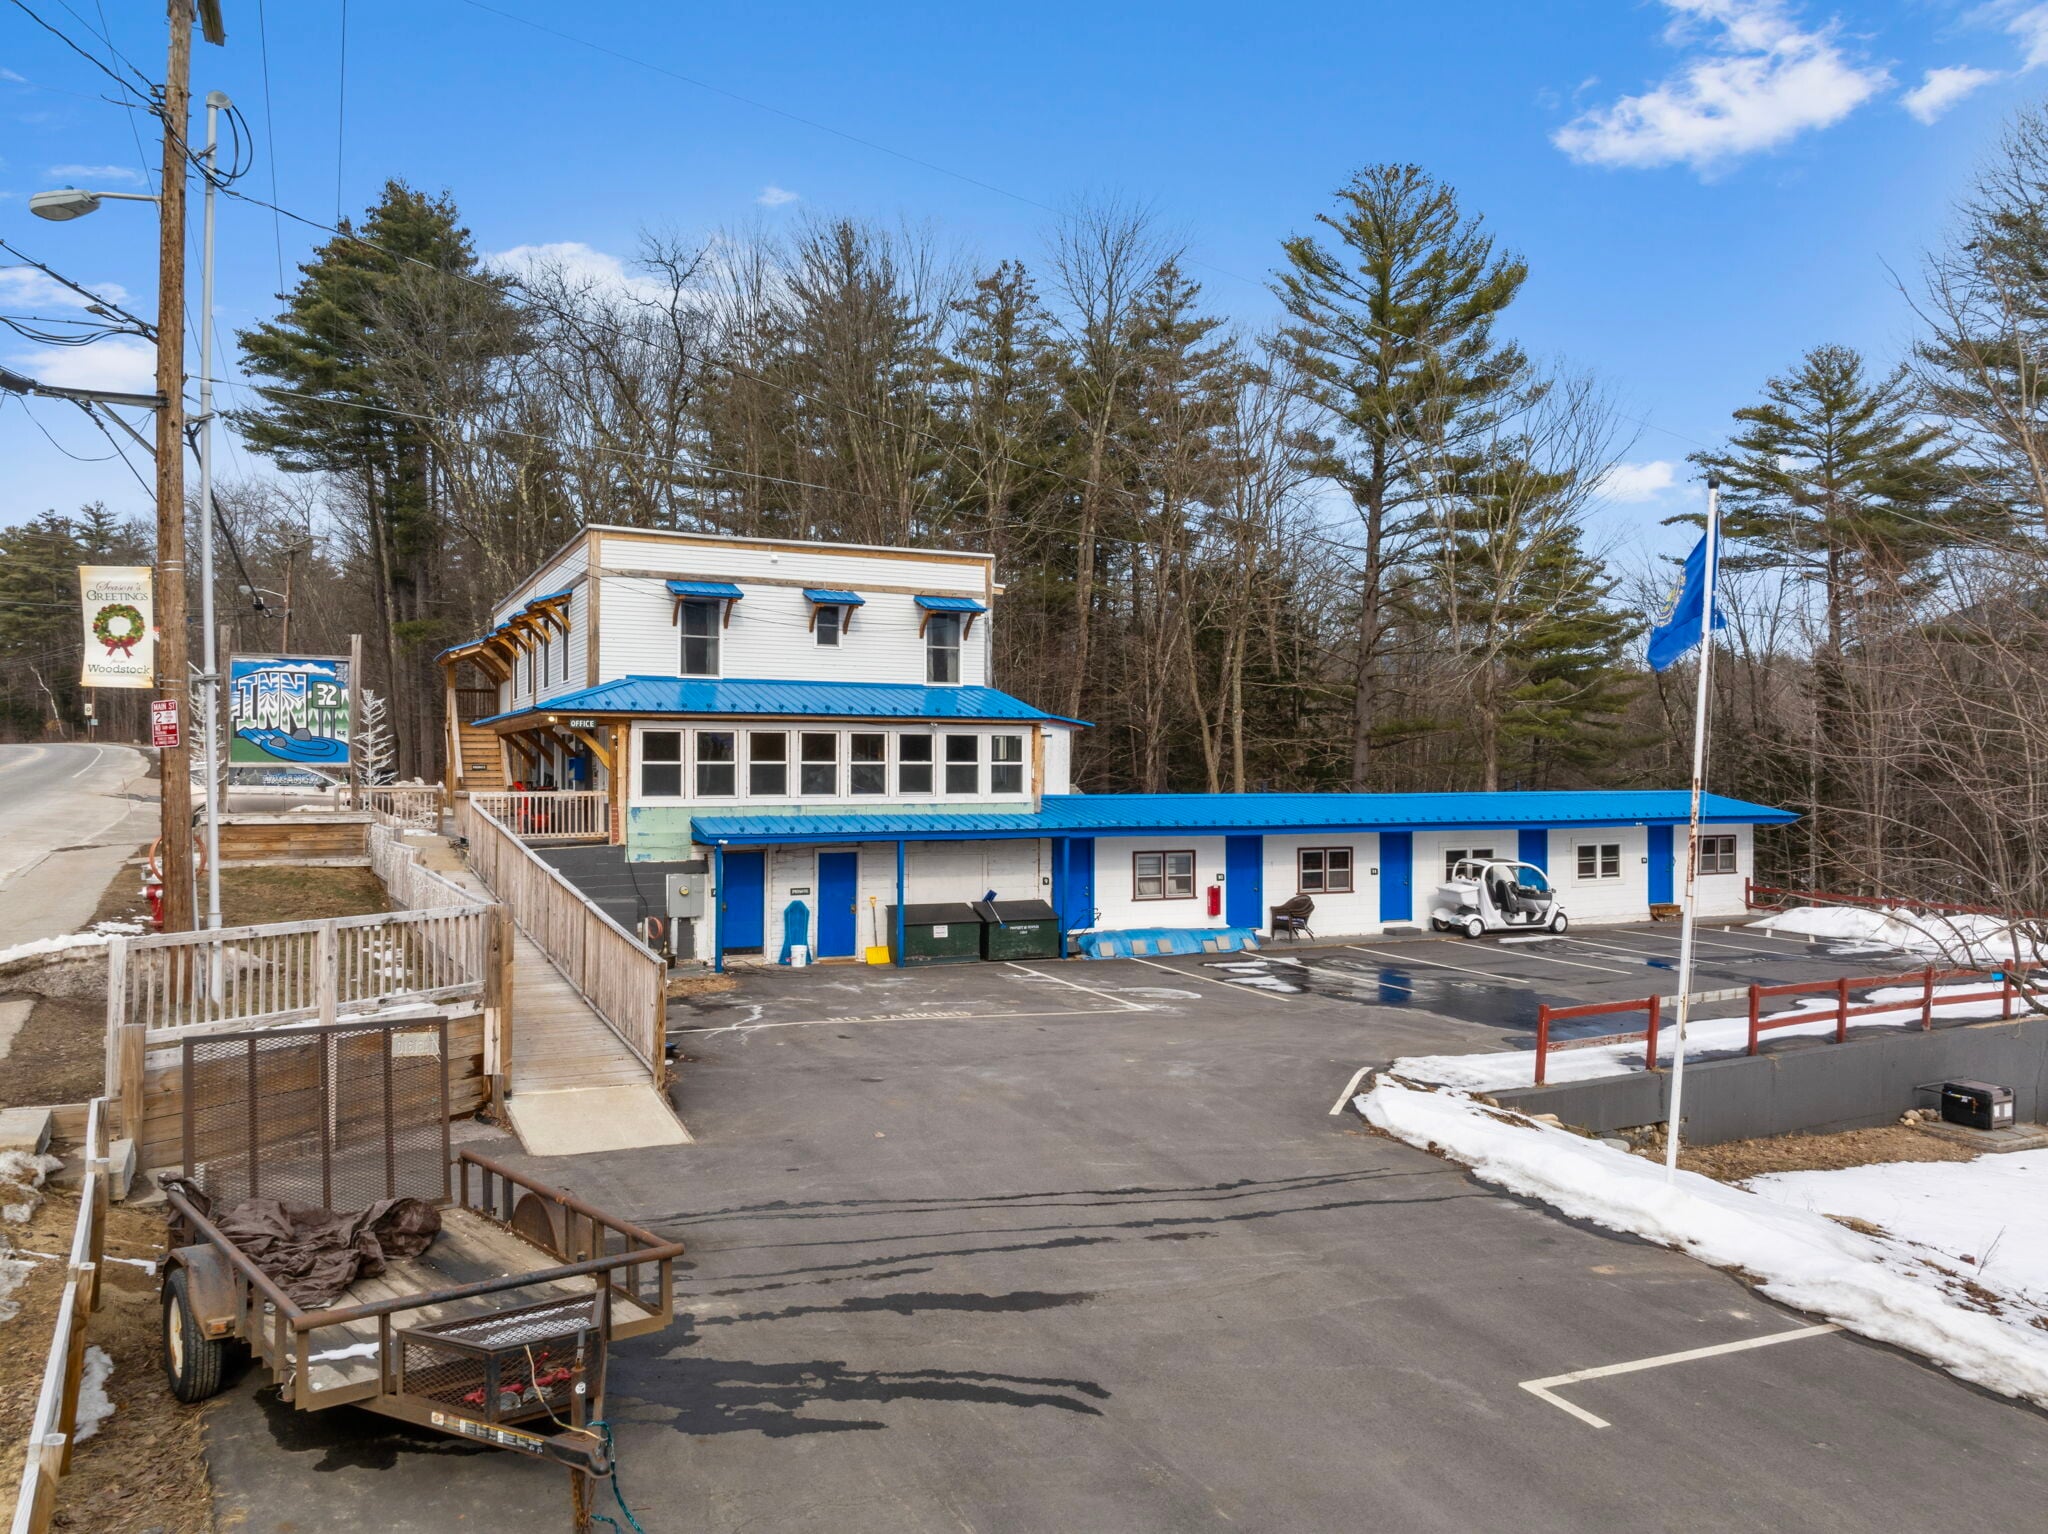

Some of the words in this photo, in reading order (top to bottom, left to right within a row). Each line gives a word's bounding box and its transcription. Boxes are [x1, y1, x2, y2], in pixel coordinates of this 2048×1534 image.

[96, 581, 141, 592] Season's
[86, 590, 149, 601] GREETINGS
[88, 664, 150, 674] Woodstock
[317, 683, 337, 706] 32
[154, 702, 166, 710] MAIN
[236, 671, 308, 736] INN
[156, 712, 162, 723] 2
